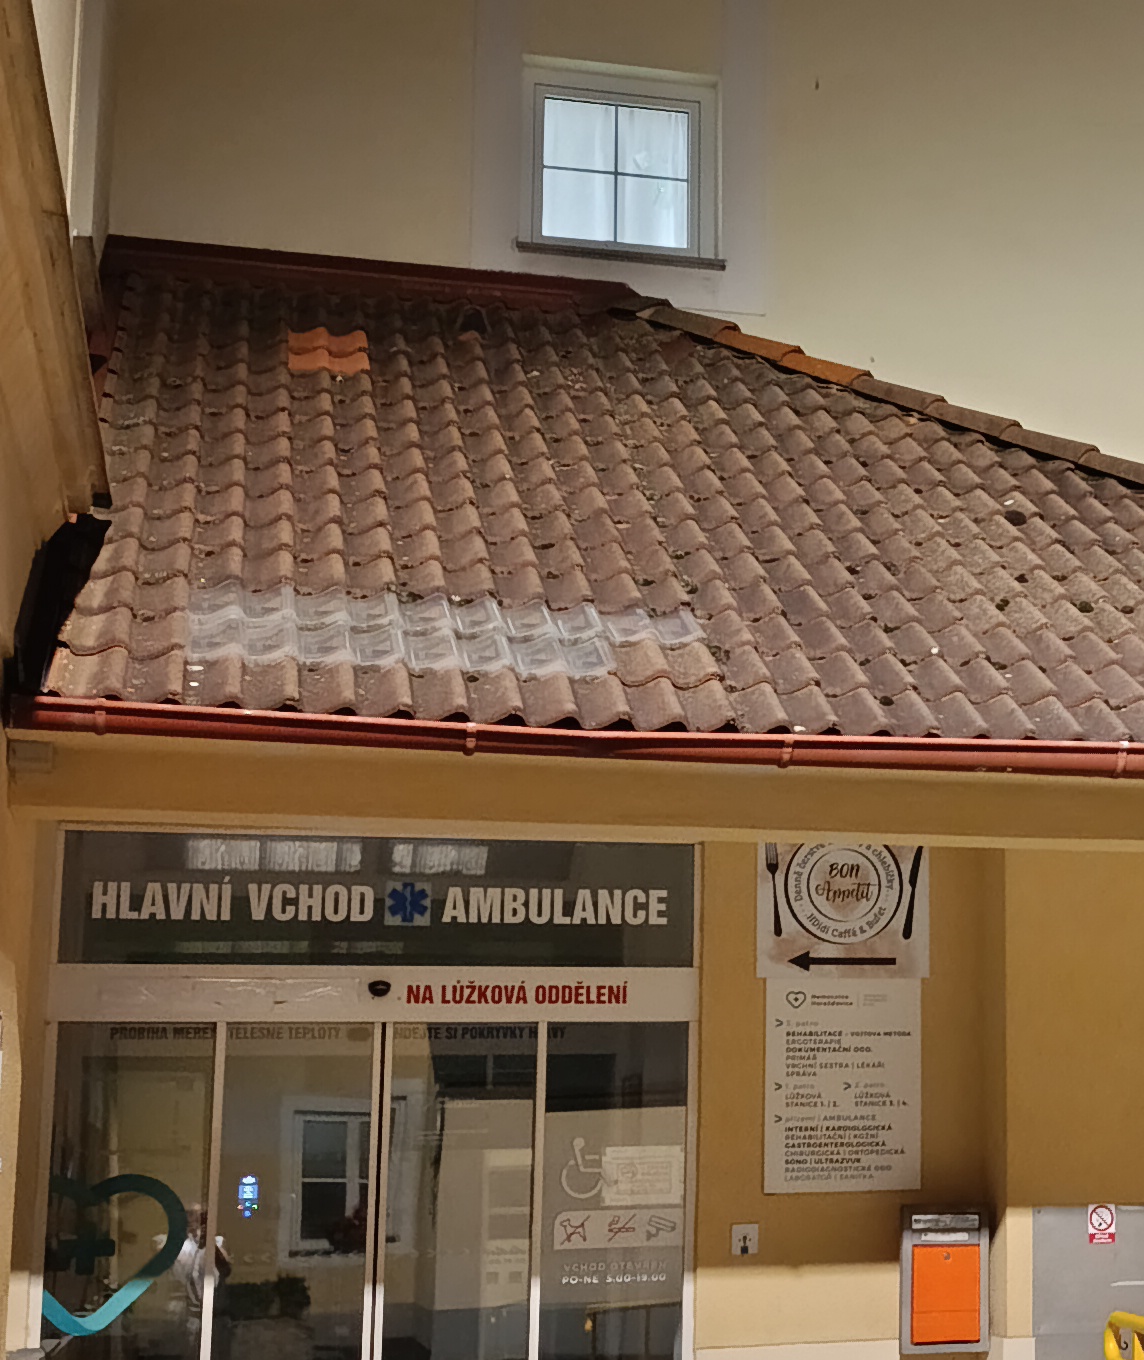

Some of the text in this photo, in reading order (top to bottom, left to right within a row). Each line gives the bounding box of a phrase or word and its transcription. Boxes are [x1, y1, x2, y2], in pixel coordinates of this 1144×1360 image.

[92, 877, 669, 926] HLAVNÍ VCHOD AMBULANCE
[406, 984, 434, 1004] NA
[534, 980, 628, 1004] ODDĚLENÍ
[288, 1026, 341, 1040] TEPLOTY
[445, 1026, 458, 1040] SI
[822, 1114, 876, 1122] AMBULANCE
[563, 1262, 606, 1272] VCHOD
[562, 1274, 599, 1285] PO-NE
